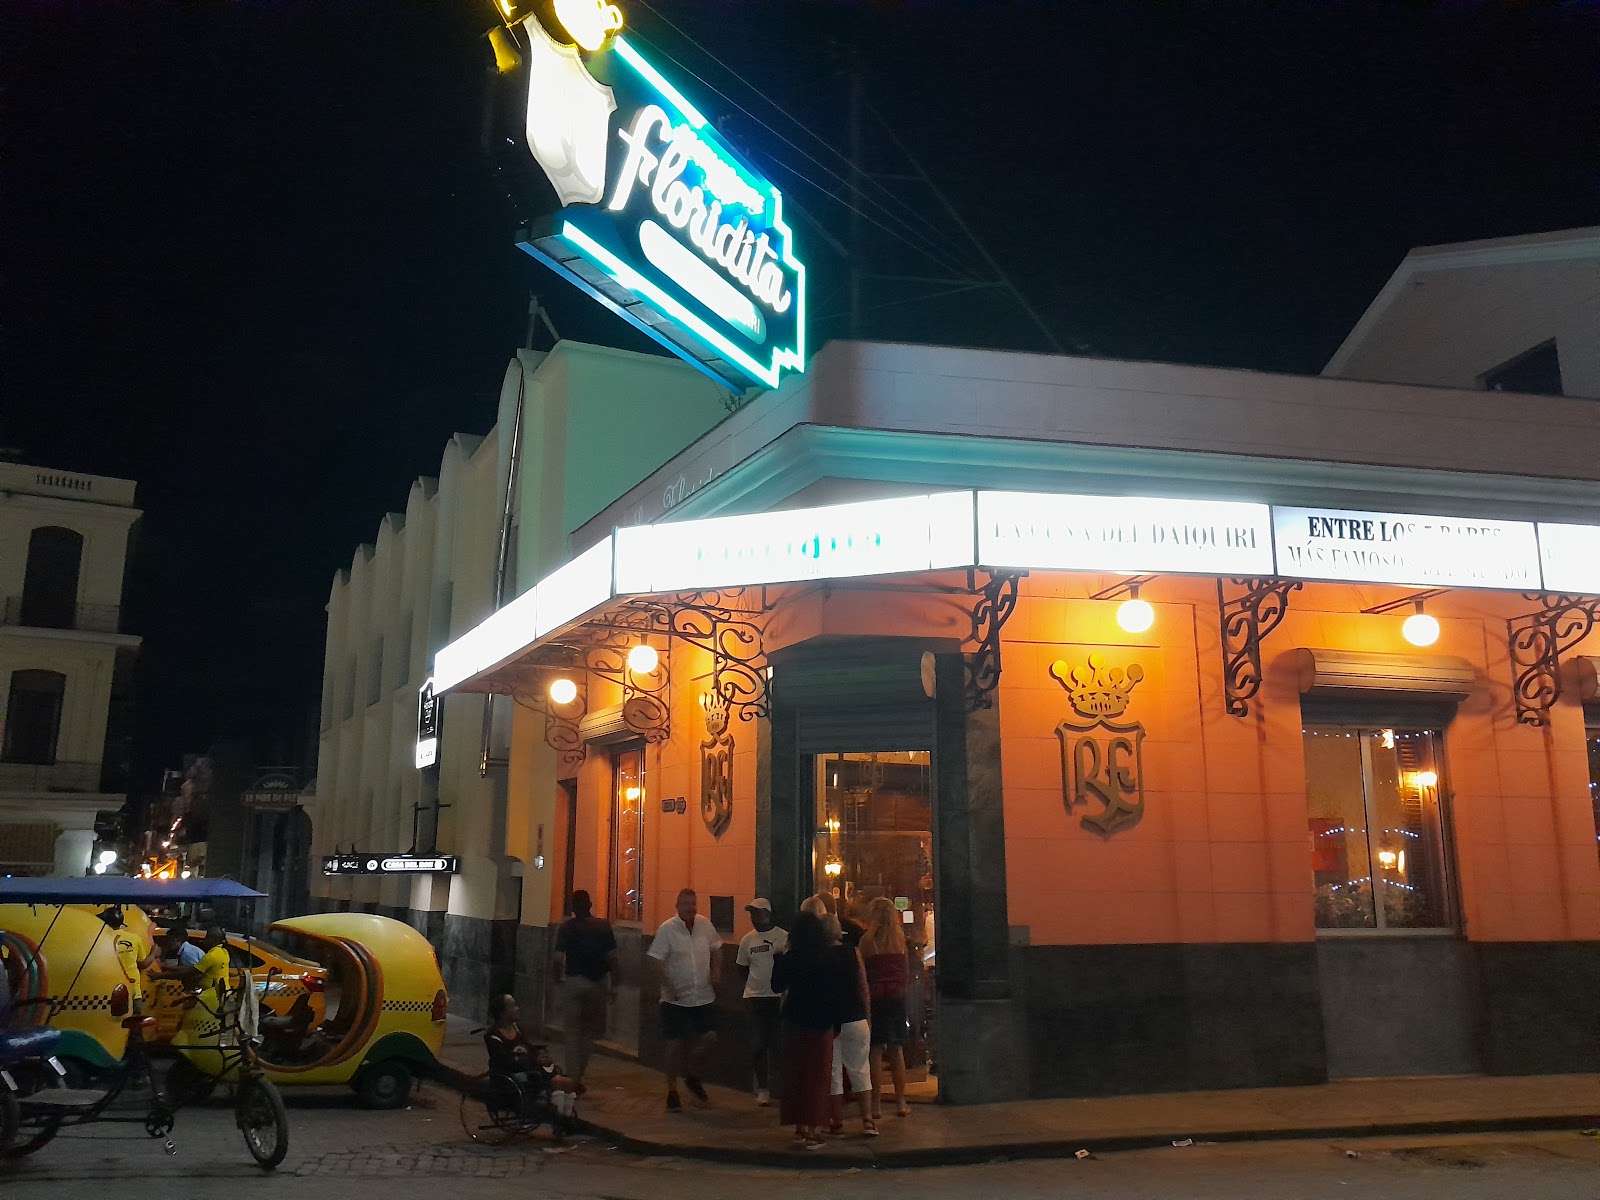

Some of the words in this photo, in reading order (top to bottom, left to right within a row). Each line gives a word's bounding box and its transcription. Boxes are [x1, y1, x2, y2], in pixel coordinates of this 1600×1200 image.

[1151, 522, 1257, 551] DAIQUIRI
[1306, 515, 1375, 542] ENTRE
[1379, 520, 1416, 543] LOS
